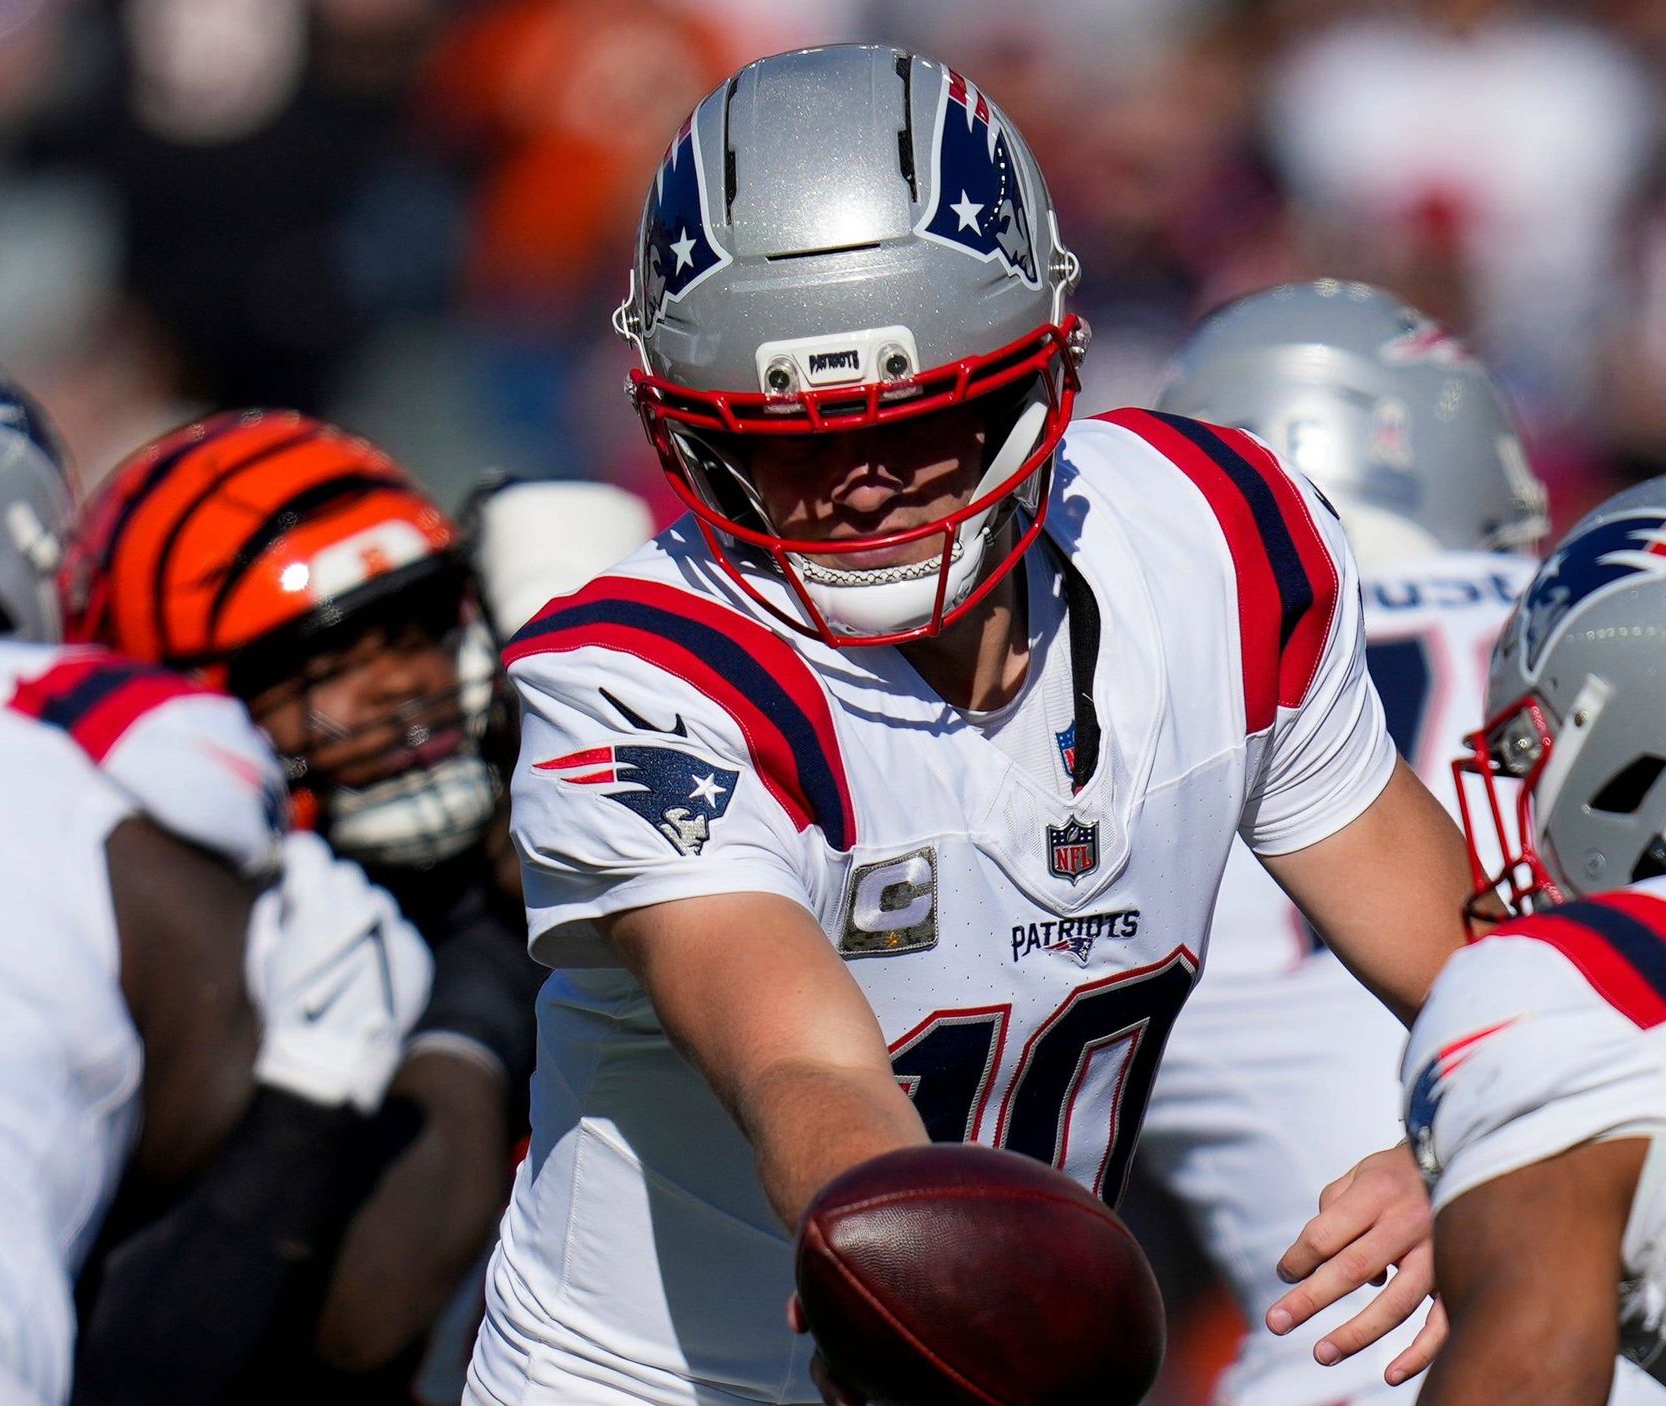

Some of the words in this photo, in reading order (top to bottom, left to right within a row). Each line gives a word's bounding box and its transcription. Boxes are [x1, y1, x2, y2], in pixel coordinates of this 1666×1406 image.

[809, 349, 860, 375] PATRIOTS
[1054, 844, 1095, 875] NFL
[851, 852, 936, 935] C
[1011, 909, 1141, 963] PATRIOTS
[886, 942, 1201, 1212] 10
